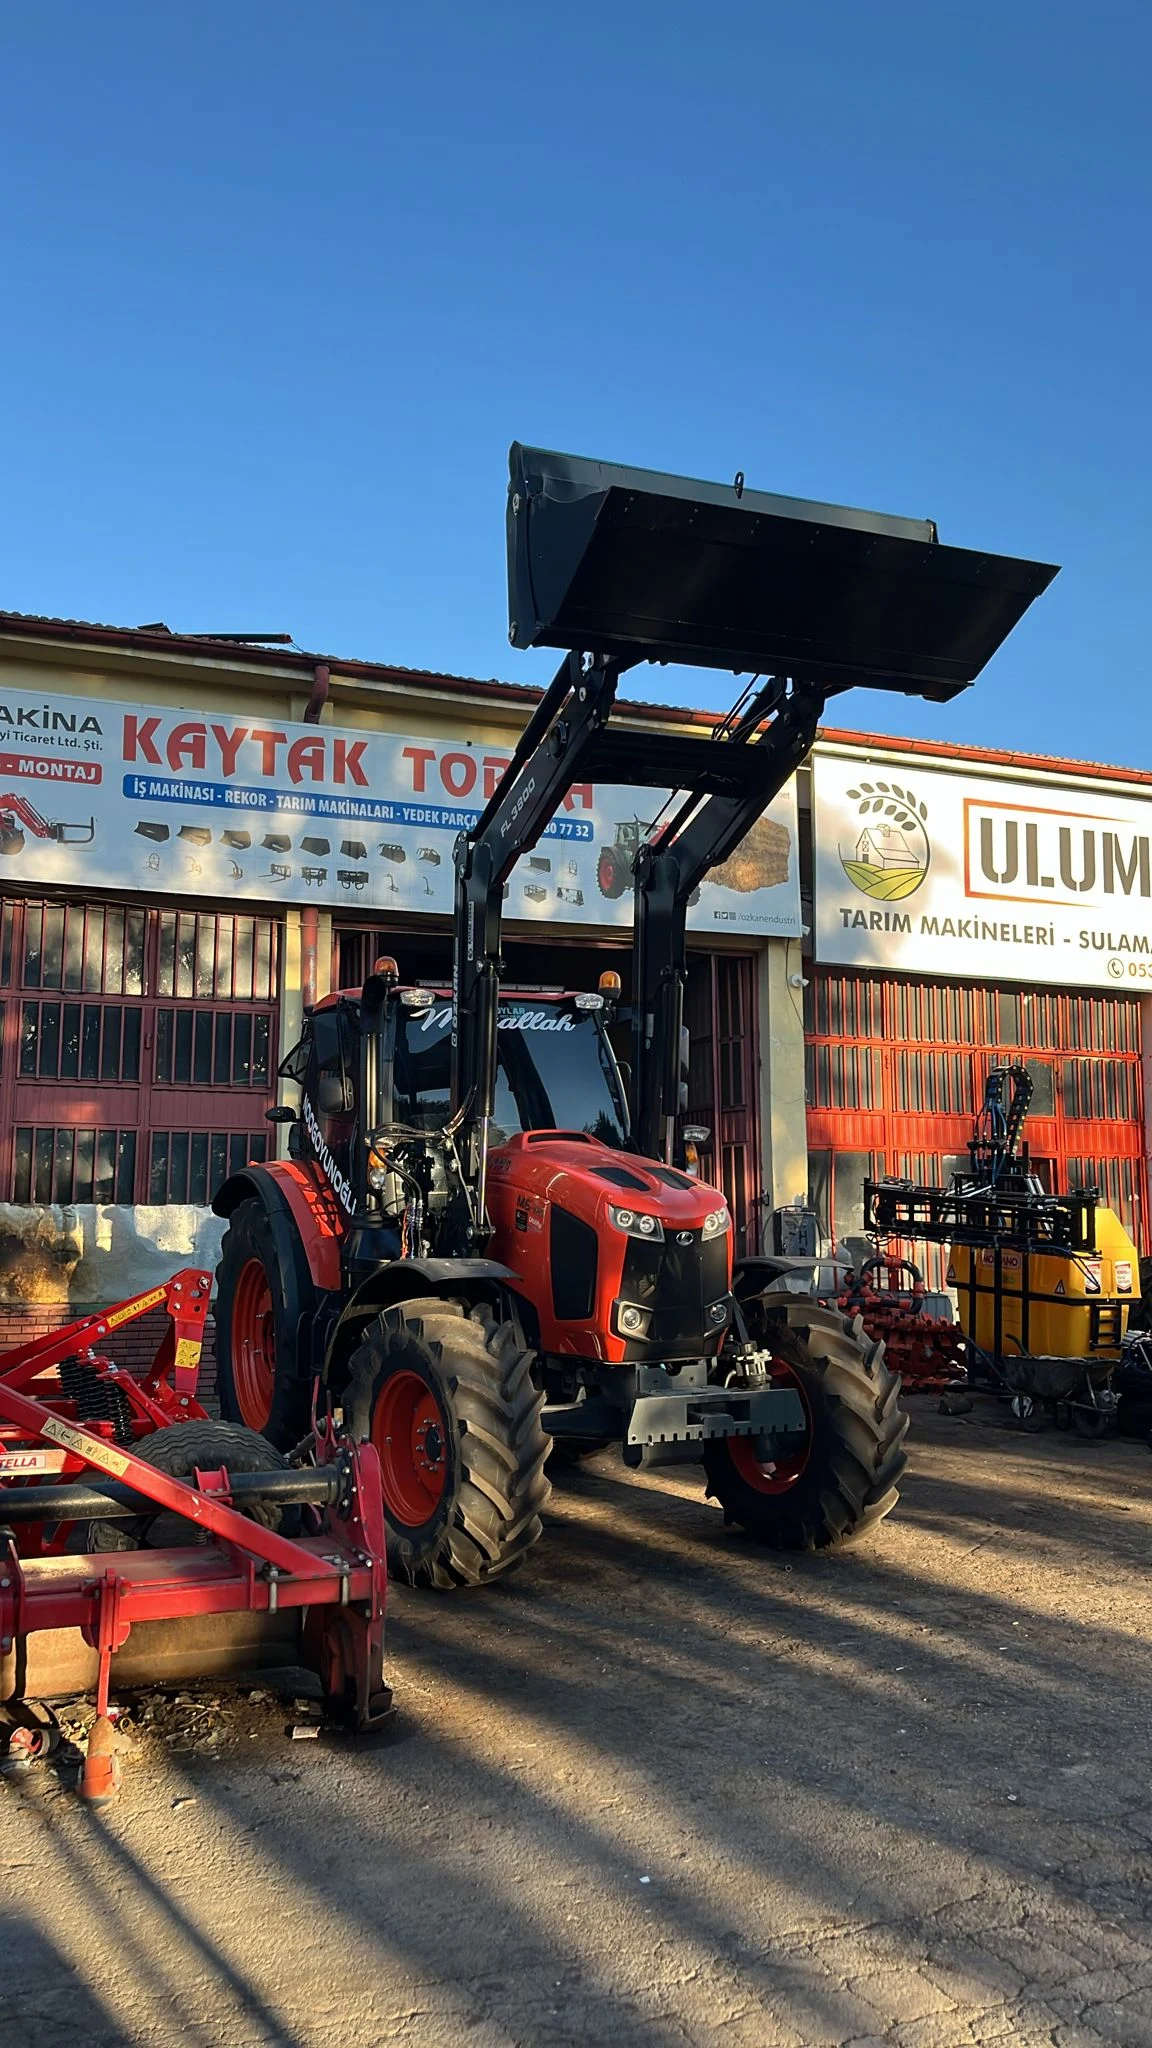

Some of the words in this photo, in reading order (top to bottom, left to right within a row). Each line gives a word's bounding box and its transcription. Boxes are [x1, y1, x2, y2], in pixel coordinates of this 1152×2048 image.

[12, 731, 55, 746] Ticaret
[58, 736, 81, 748] Ltd.
[84, 739, 103, 752] Şti.
[18, 759, 96, 780] MONTAJ
[122, 715, 369, 787] KAYTAK
[402, 747, 593, 812] TORA
[134, 778, 147, 798] İŞ
[149, 779, 214, 802] MAKİNASI
[225, 790, 267, 807] REKOR
[277, 796, 316, 812] TARIM
[318, 799, 394, 820] MAKİNALARI
[403, 807, 440, 822] YEDEK
[441, 812, 478, 829] PARÇA
[559, 823, 573, 836] 77
[575, 825, 589, 837] 32
[500, 819, 512, 838] FL
[510, 777, 536, 821] 3800
[980, 817, 1151, 898] ULUM
[839, 908, 912, 933] TARIM
[920, 914, 1055, 946] MAKİNELERİ
[1079, 930, 1152, 955] SULAM
